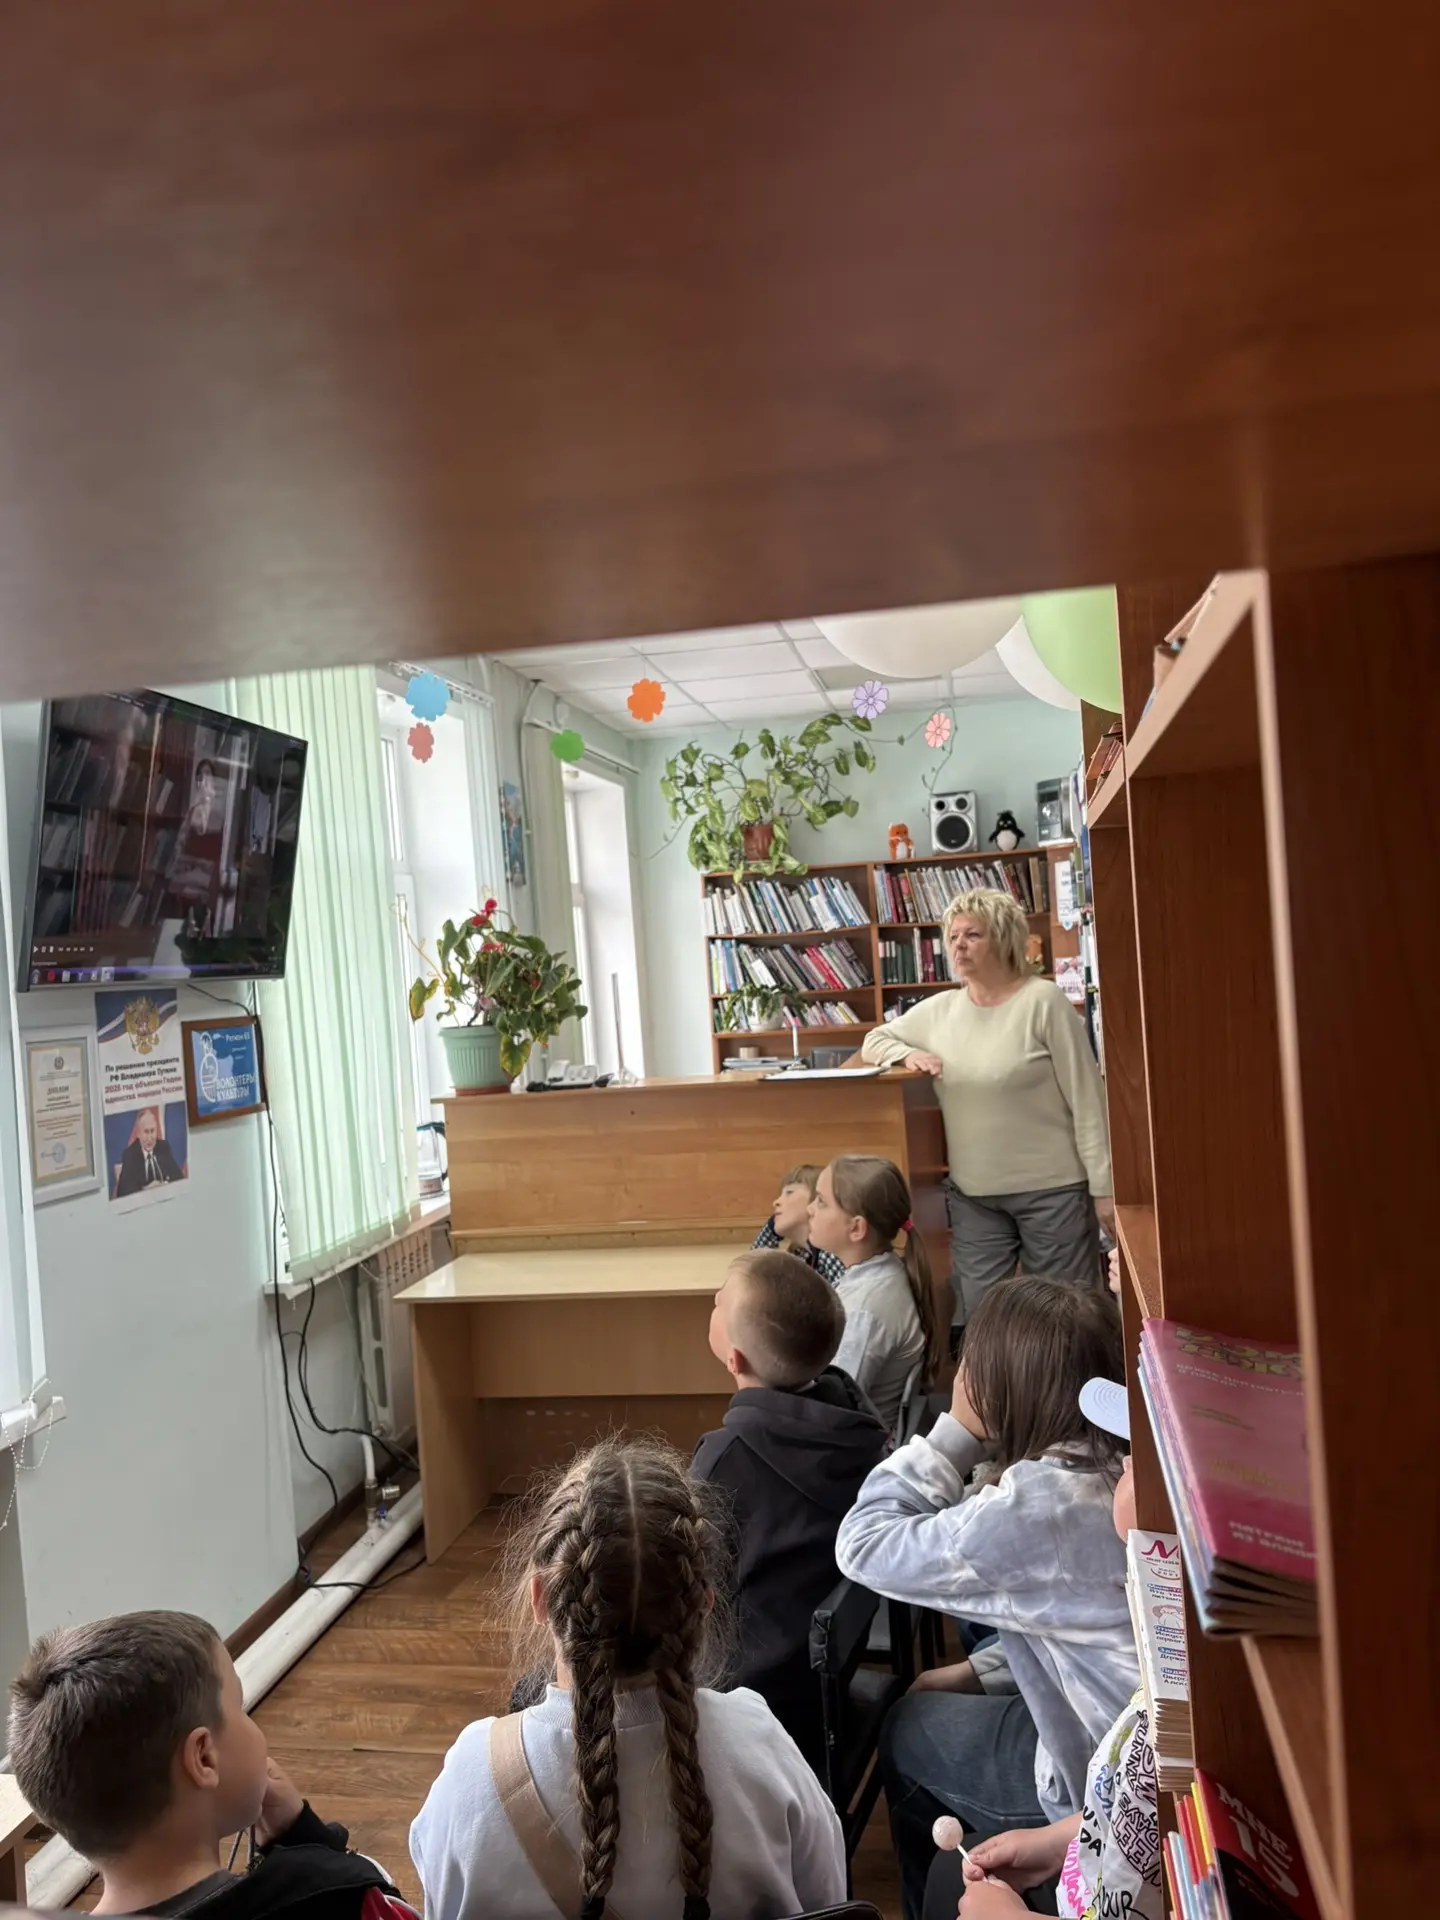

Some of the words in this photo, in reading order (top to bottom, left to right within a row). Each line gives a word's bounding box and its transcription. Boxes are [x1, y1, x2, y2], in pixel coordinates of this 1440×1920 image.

[105, 1064, 114, 1073] По
[120, 1070, 157, 1081] Владимира
[1229, 1815, 1300, 1898] 15
